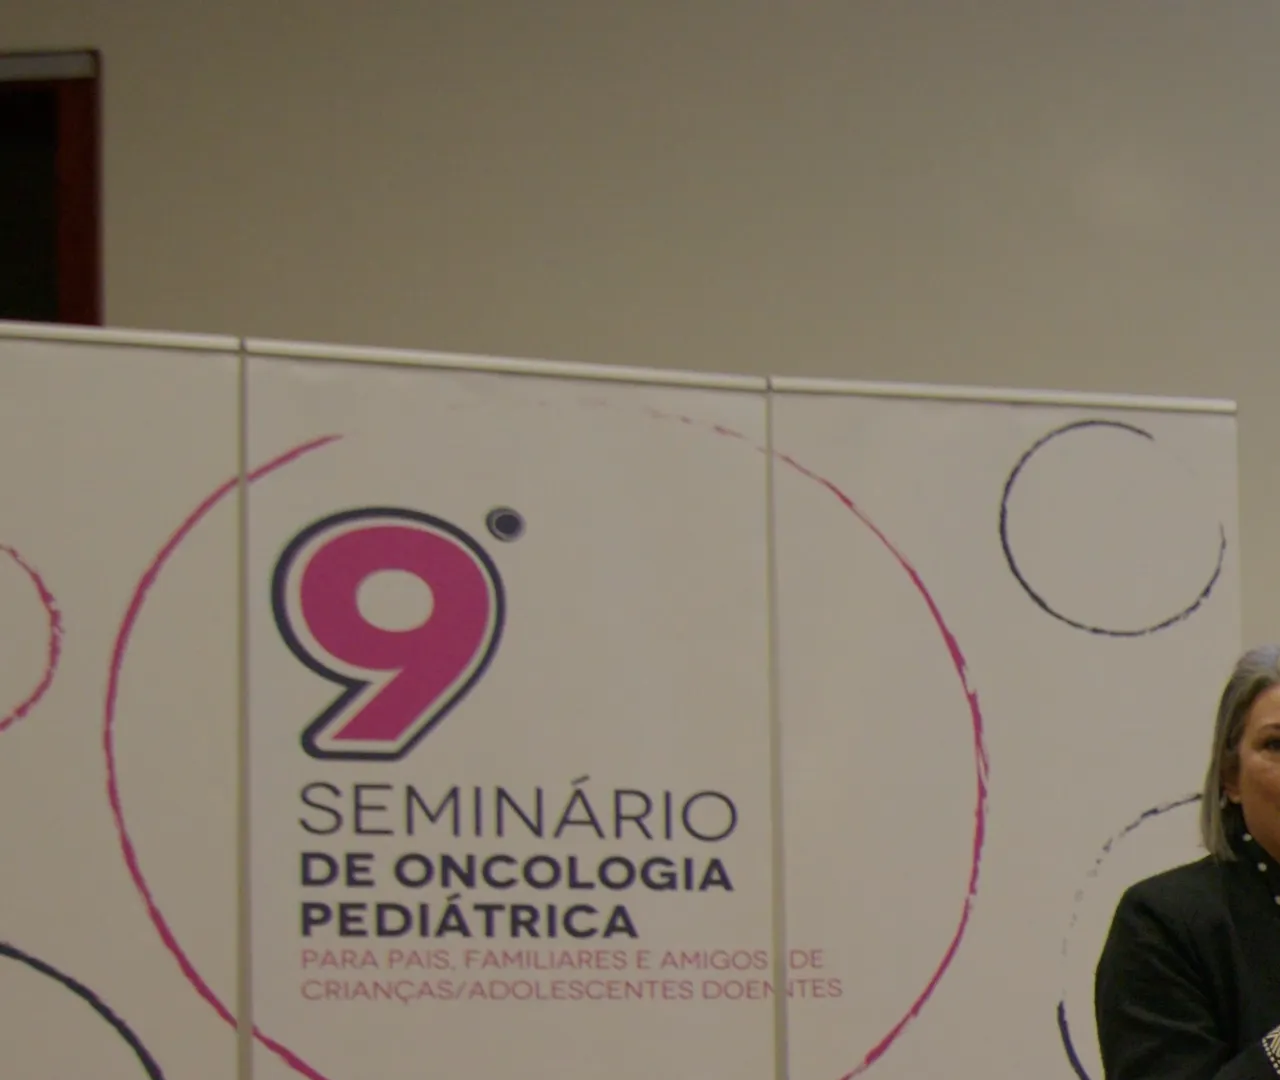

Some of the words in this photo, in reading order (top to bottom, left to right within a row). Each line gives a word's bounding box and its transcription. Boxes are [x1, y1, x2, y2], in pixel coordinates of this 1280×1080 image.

[298, 775, 738, 842] SEMINÁRIO
[300, 851, 375, 889] DE
[393, 852, 734, 893] ONCOLOGIA
[300, 893, 639, 940] PEDIÁTRICA
[301, 949, 379, 970] PARA
[387, 949, 456, 972] PAIS,
[464, 950, 628, 971] FAMILIARES
[636, 950, 650, 970] E
[660, 949, 769, 971] AMIGOS
[790, 949, 824, 970] DE
[300, 979, 694, 1006] CRIANÇAS/ADOLESCENTES
